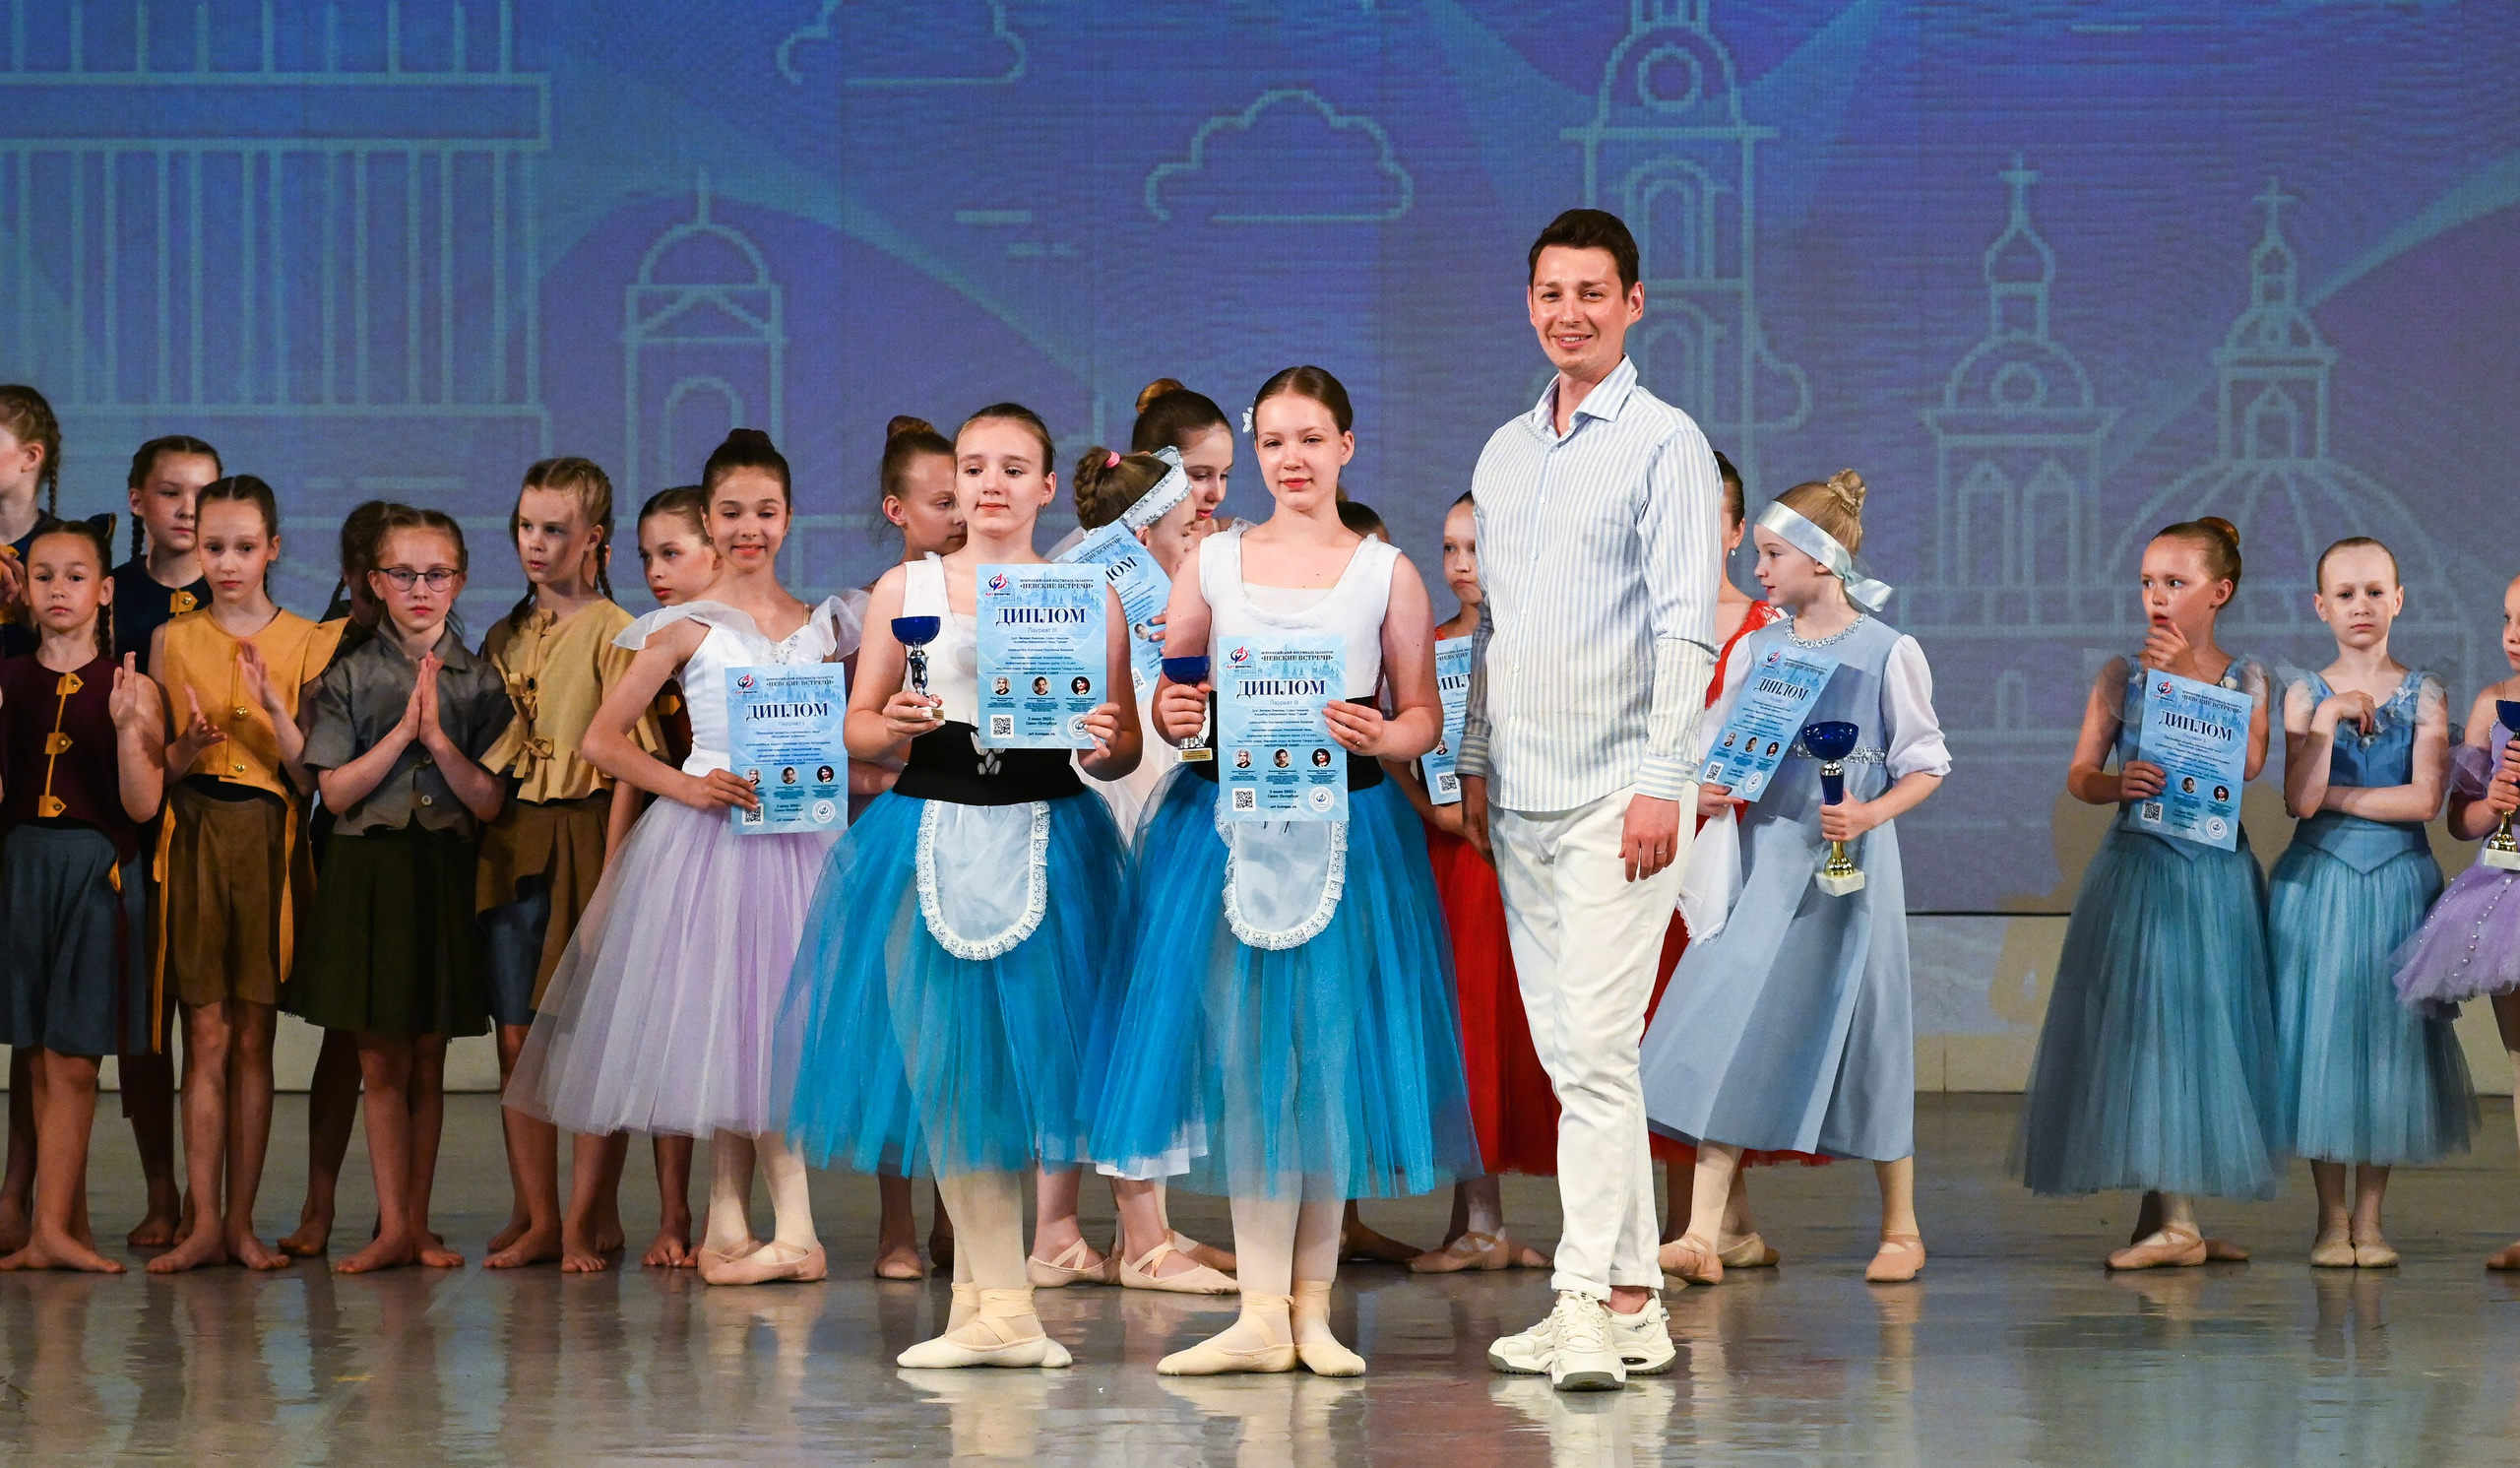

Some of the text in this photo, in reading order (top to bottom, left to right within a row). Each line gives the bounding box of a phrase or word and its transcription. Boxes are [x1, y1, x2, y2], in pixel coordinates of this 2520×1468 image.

[995, 607, 1087, 627] ДИПЛОМ
[1236, 679, 1326, 700] ДИПЛОМ
[1753, 677, 1809, 701] ДИПЛОМ
[746, 702, 829, 722] ДИПЛОМ
[2159, 710, 2233, 741] ДИПЛОМ
